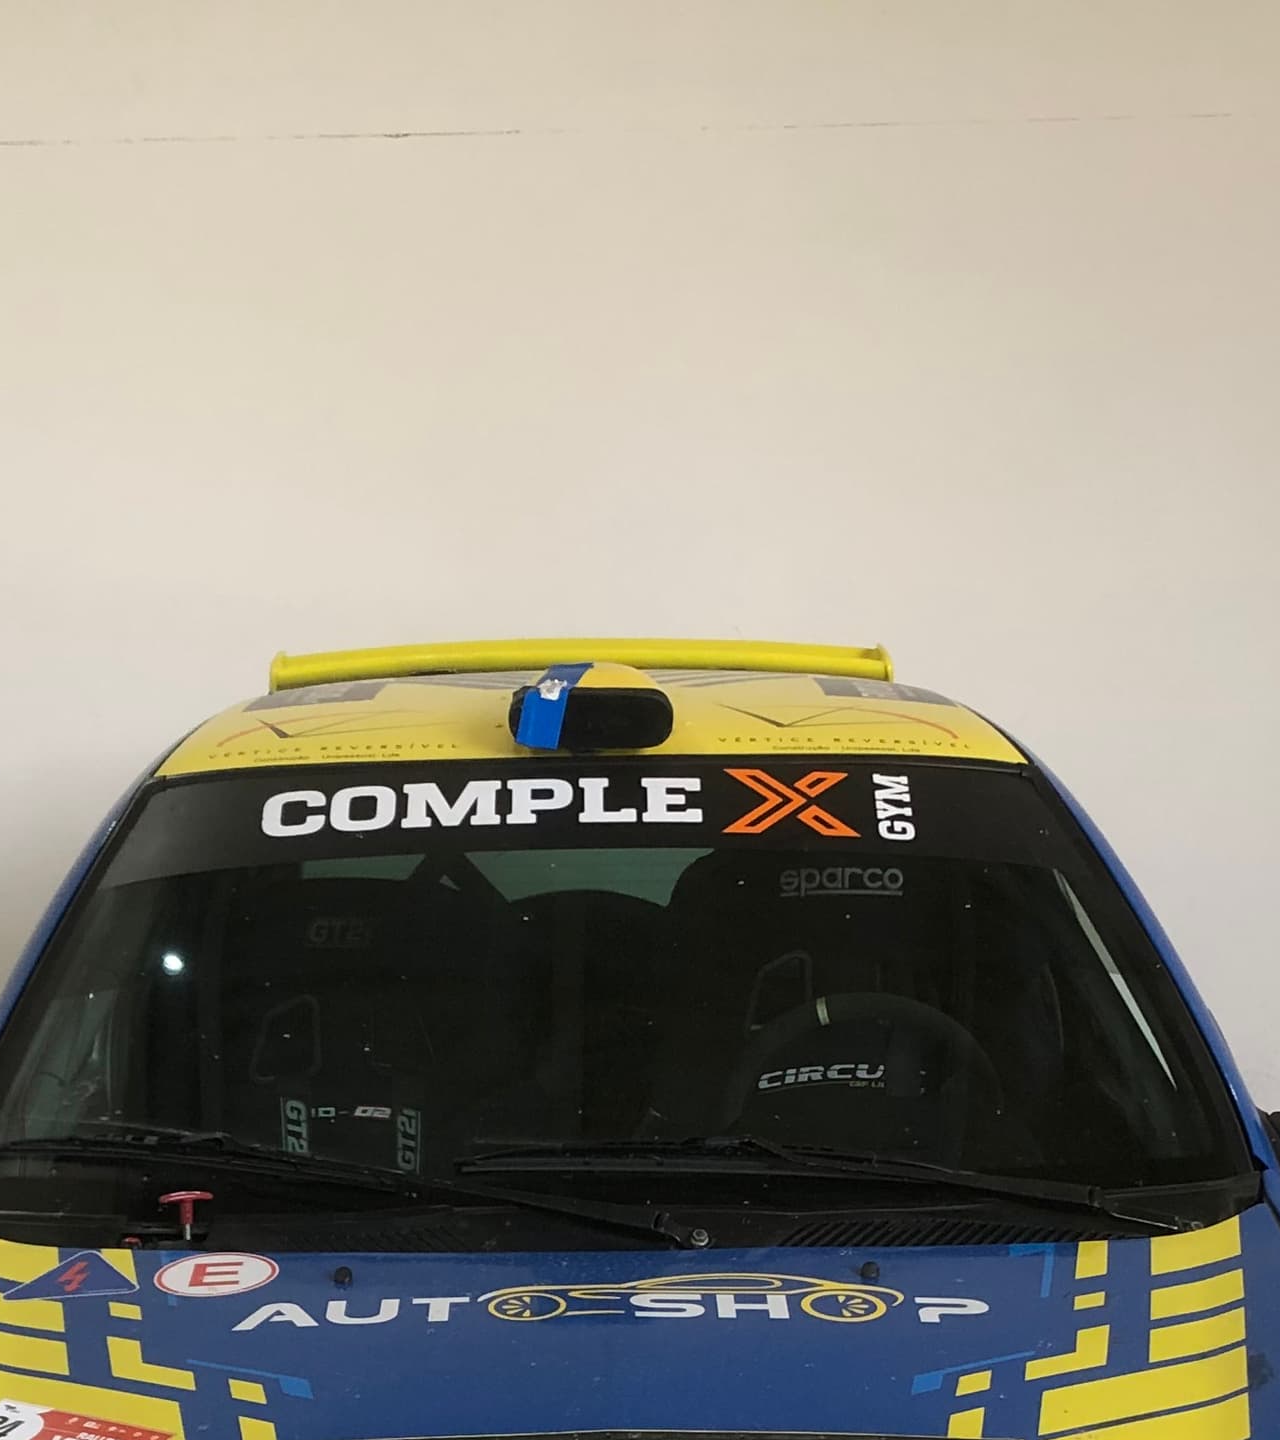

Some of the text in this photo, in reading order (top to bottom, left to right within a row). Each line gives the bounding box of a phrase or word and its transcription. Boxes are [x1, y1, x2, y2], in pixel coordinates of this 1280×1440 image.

[871, 773, 916, 841] GYM
[779, 865, 904, 896] sparco
[188, 1262, 244, 1287] E
